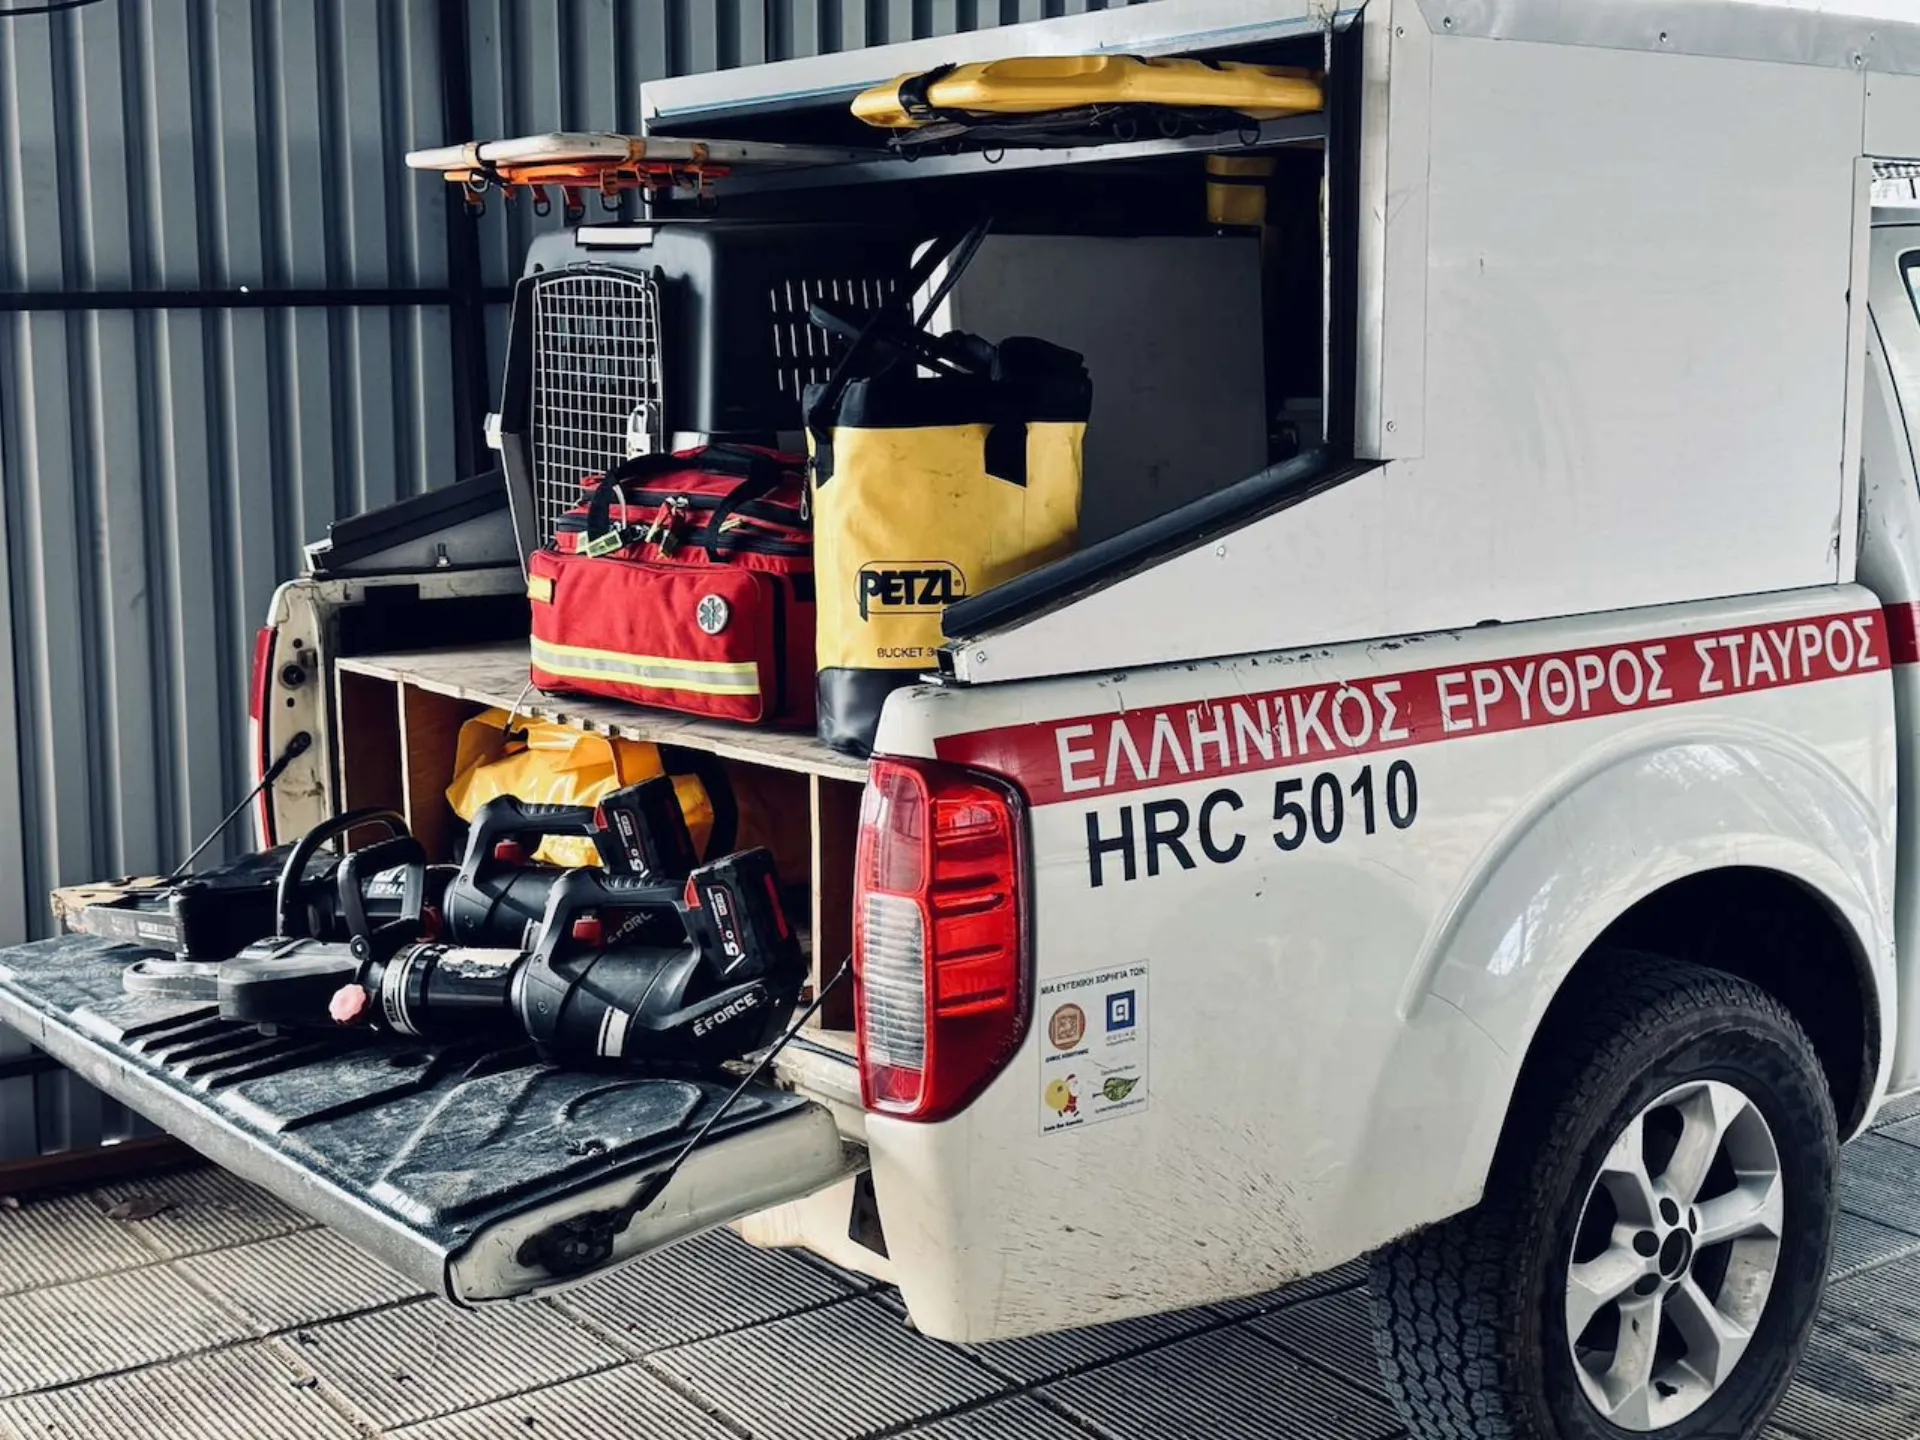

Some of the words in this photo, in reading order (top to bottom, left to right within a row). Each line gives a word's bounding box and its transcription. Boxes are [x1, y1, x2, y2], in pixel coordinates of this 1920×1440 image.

[860, 570, 961, 621] PETZL
[877, 647, 923, 658] BUCKET
[926, 647, 936, 658] 3
[1055, 681, 1409, 793] ΕΛΛΗΝΙΚΟΣ
[1435, 645, 1672, 732] ΕΡΥΘΡΟΣ
[1694, 616, 1879, 694] ΣΤΑΥΡΟΣ
[1086, 788, 1246, 888] HRC
[1272, 759, 1418, 851] 5010
